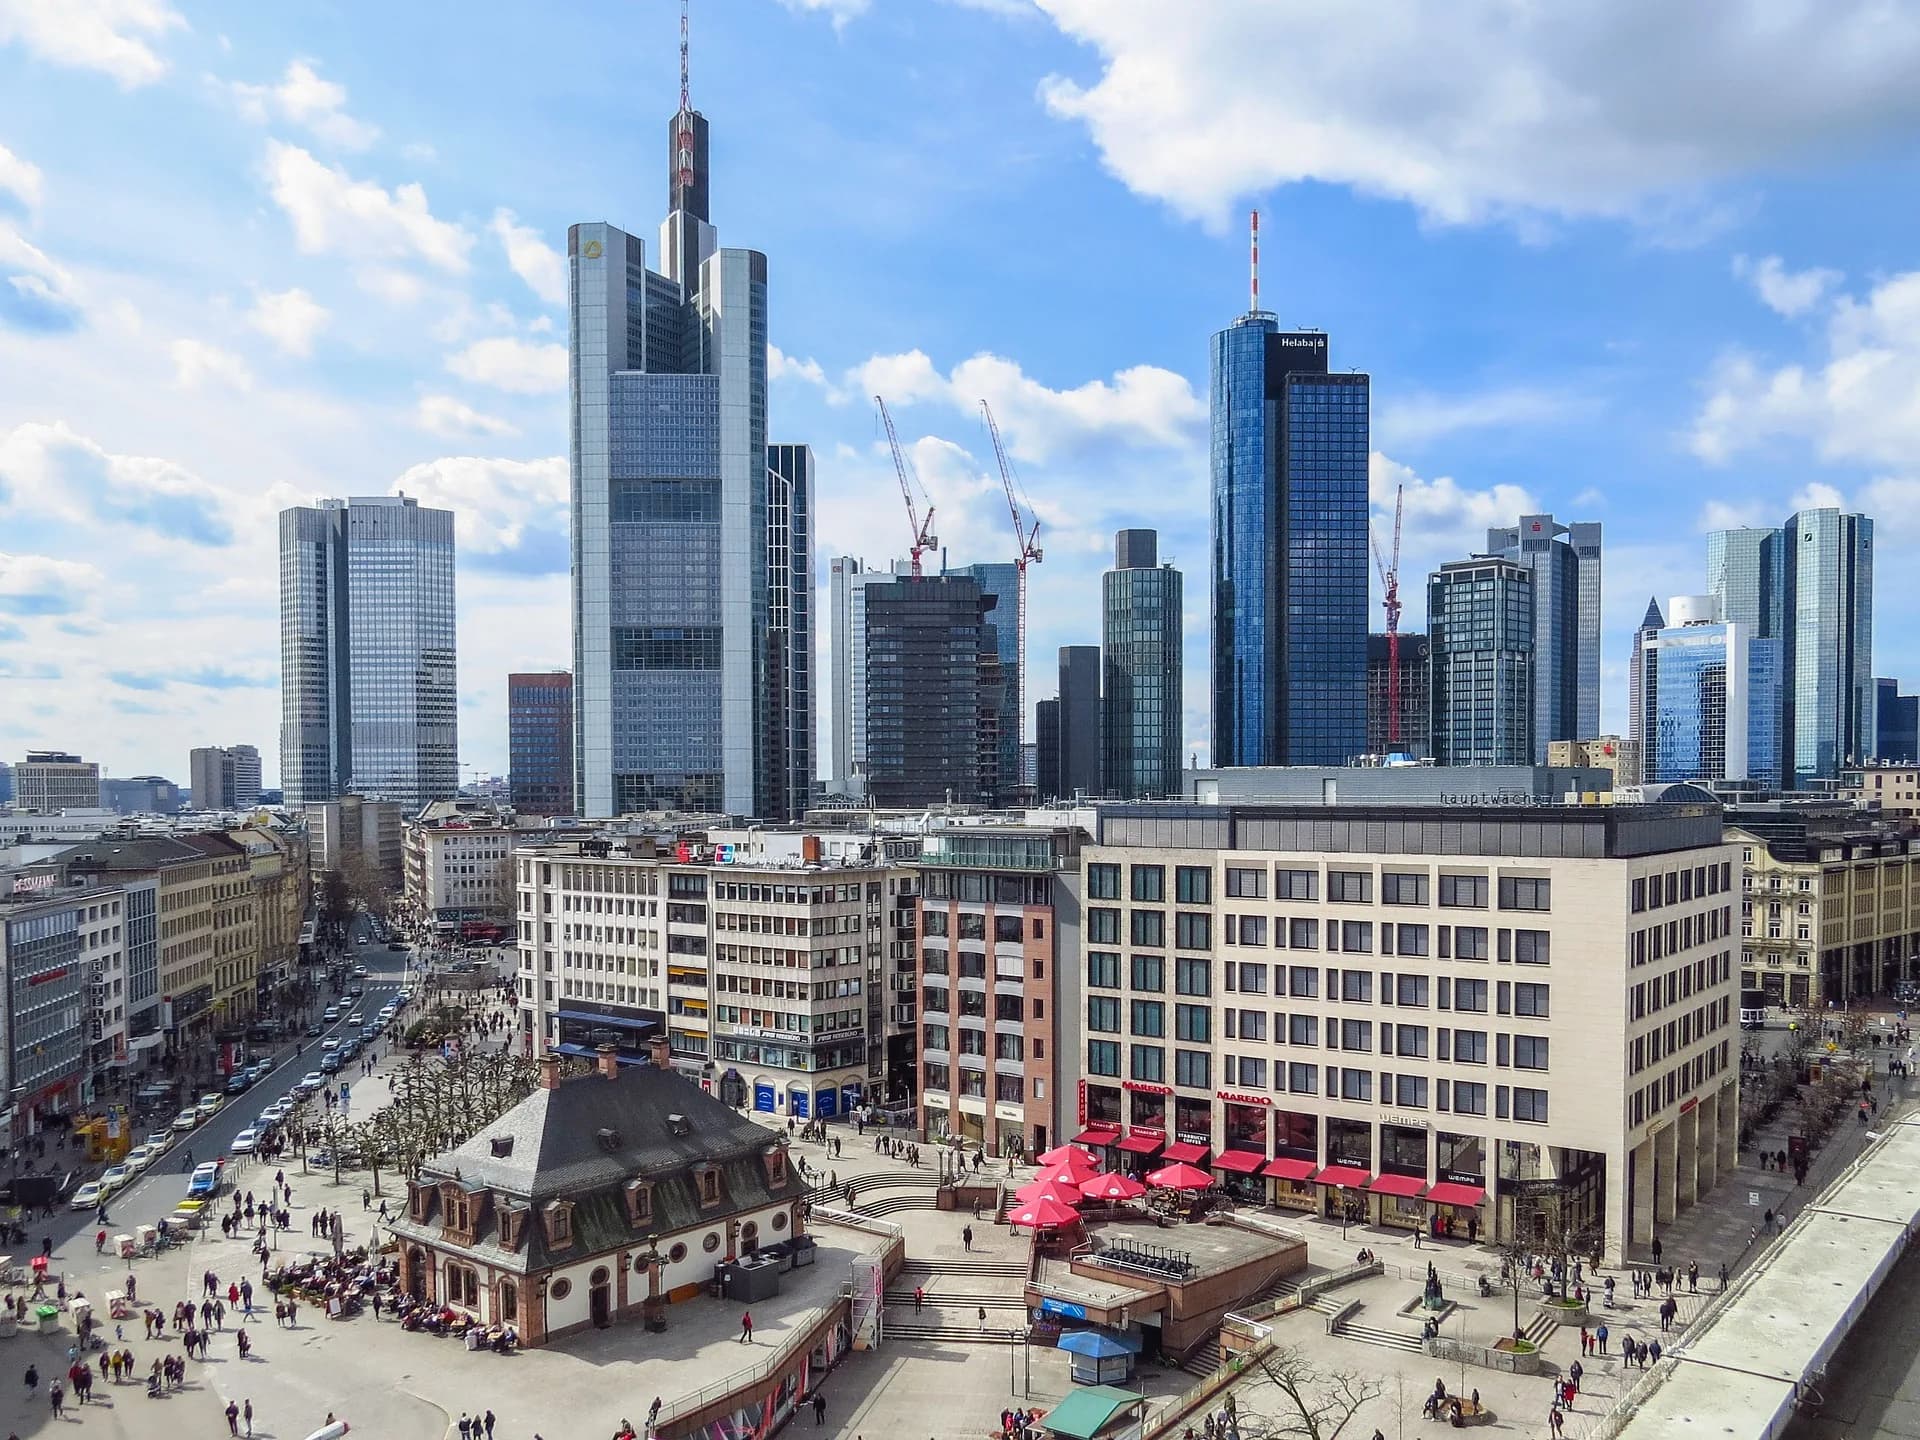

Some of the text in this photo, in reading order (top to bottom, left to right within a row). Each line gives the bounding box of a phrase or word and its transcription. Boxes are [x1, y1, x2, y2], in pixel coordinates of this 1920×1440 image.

[1281, 338, 1313, 347] Helaba
[93, 962, 102, 1017] HOTEL
[1122, 1081, 1174, 1095] MAREDO
[1216, 1091, 1271, 1105] MAREDO
[1379, 1113, 1428, 1128] WEMPE
[1178, 1132, 1207, 1142] STARBUCKS
[1183, 1137, 1201, 1145] COFFEE
[1337, 1157, 1361, 1167] WEMPE
[1448, 1174, 1475, 1184] WEMPE
